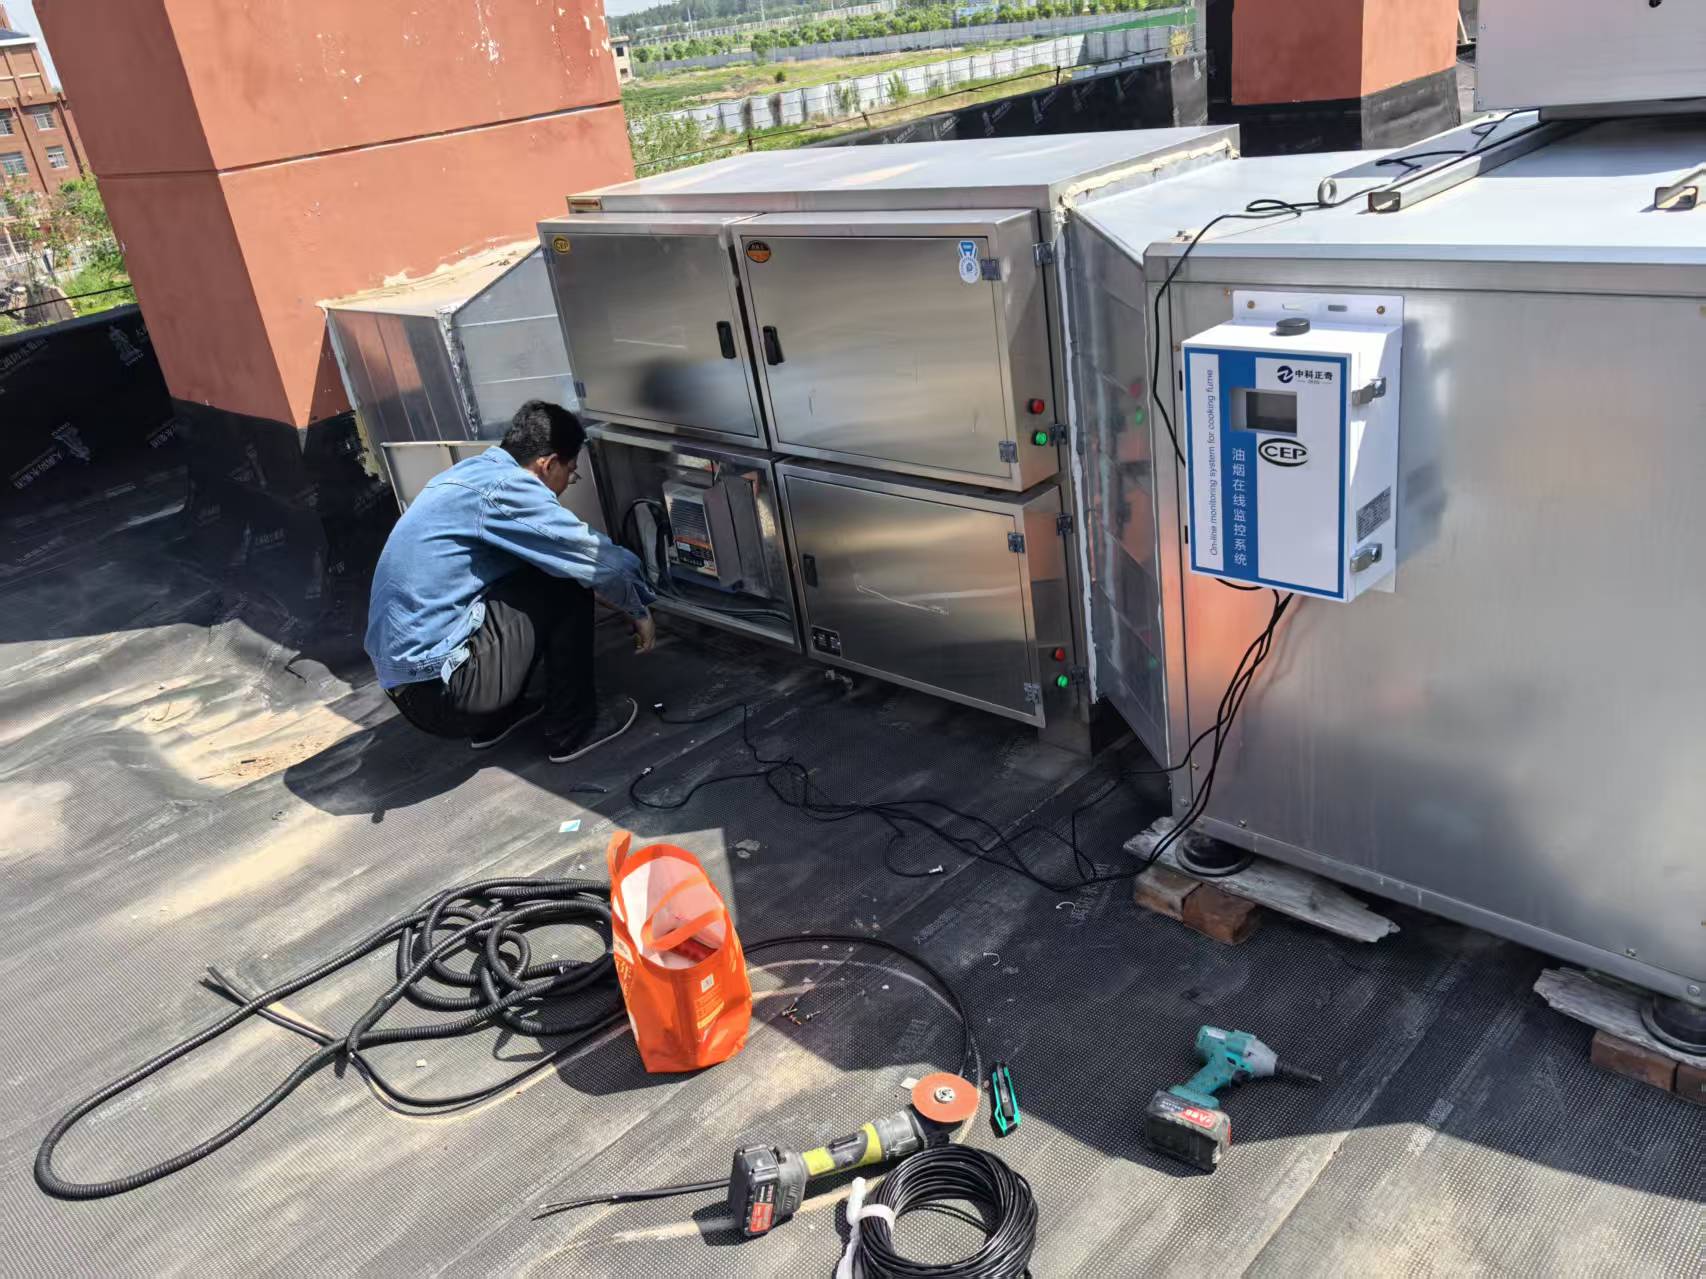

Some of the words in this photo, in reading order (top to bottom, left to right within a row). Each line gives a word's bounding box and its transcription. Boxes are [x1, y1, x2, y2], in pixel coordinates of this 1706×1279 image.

[1206, 369, 1214, 393] fume
[1294, 369, 1333, 381] 中科正奇
[1207, 396, 1216, 430] cooking
[1208, 447, 1217, 477] system
[1264, 445, 1307, 460] CEP
[1209, 480, 1217, 524] monitoring
[1232, 448, 1247, 566] 油烟在线监控系统
[1209, 525, 1217, 556] On-line
